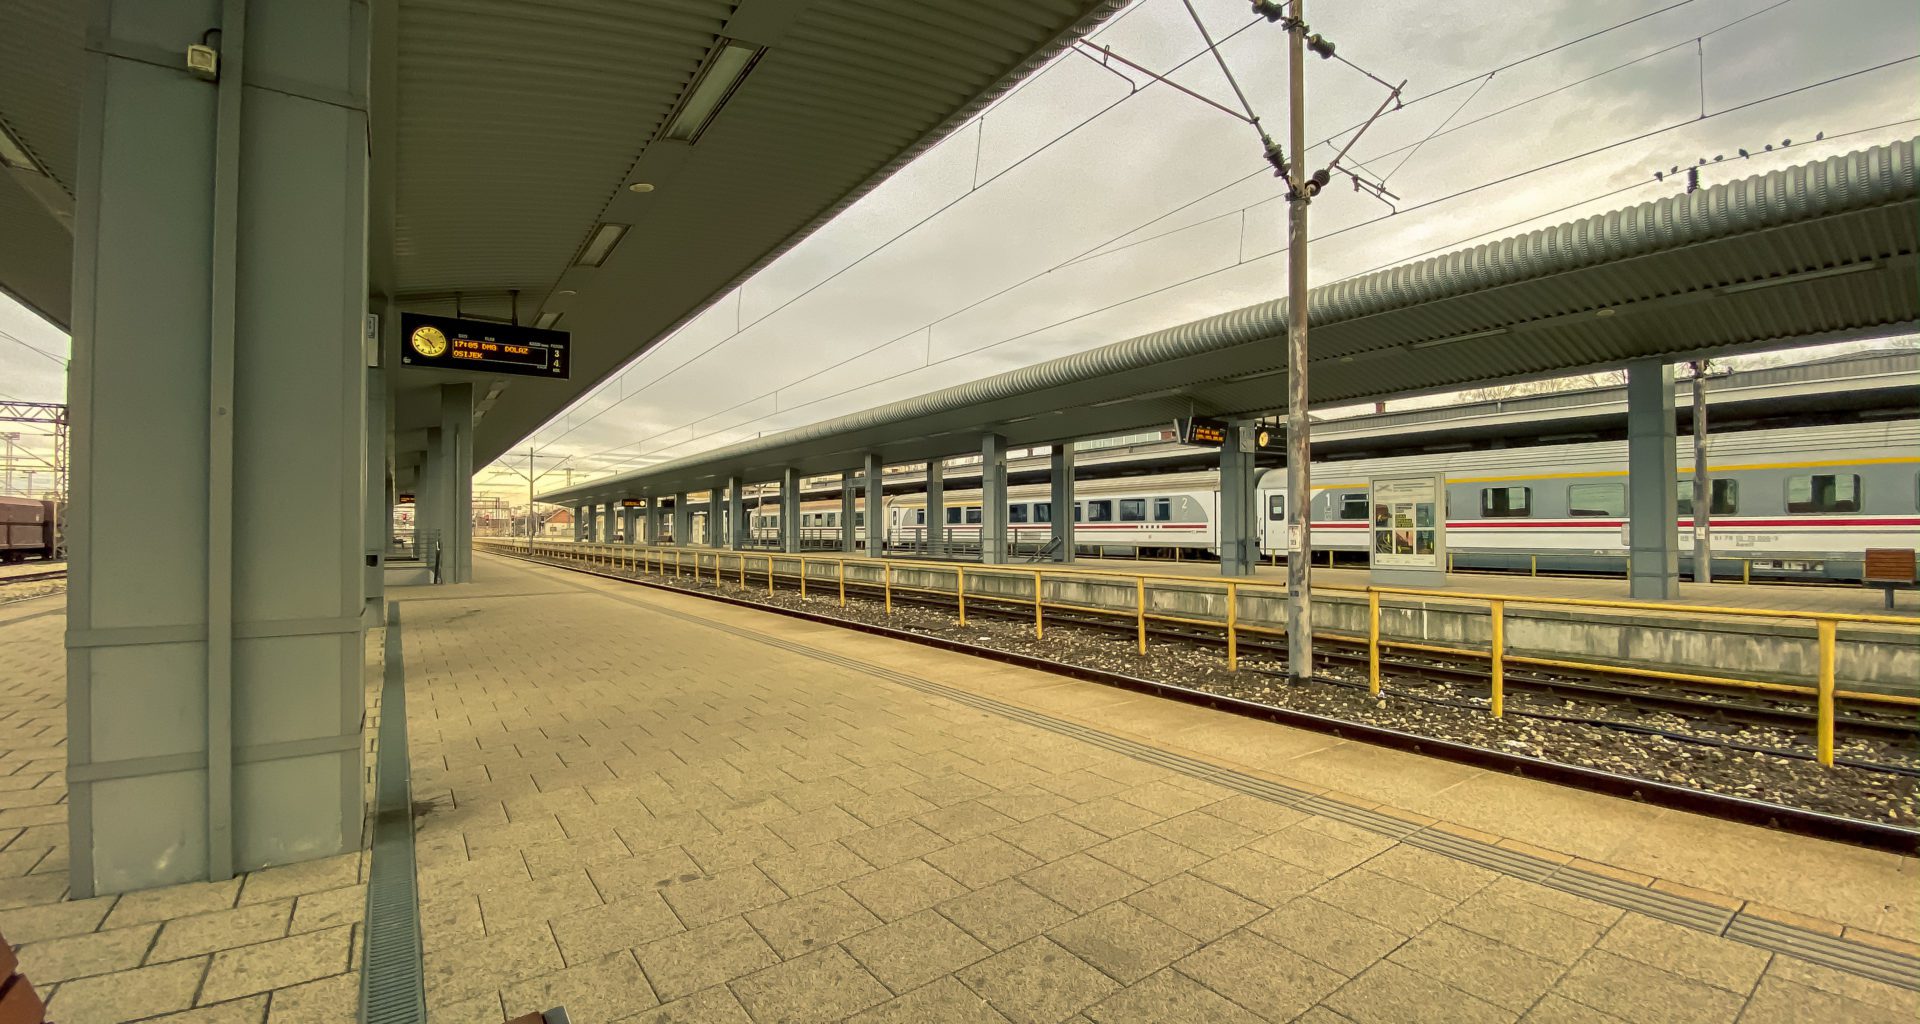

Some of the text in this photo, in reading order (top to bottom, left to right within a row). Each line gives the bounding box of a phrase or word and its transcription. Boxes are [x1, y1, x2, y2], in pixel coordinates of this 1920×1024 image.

[454, 341, 478, 349] 17:05
[453, 350, 483, 359] OSIJEK
[554, 349, 560, 357] 3
[1182, 497, 1188, 509] 2
[1326, 493, 1330, 507] 1
